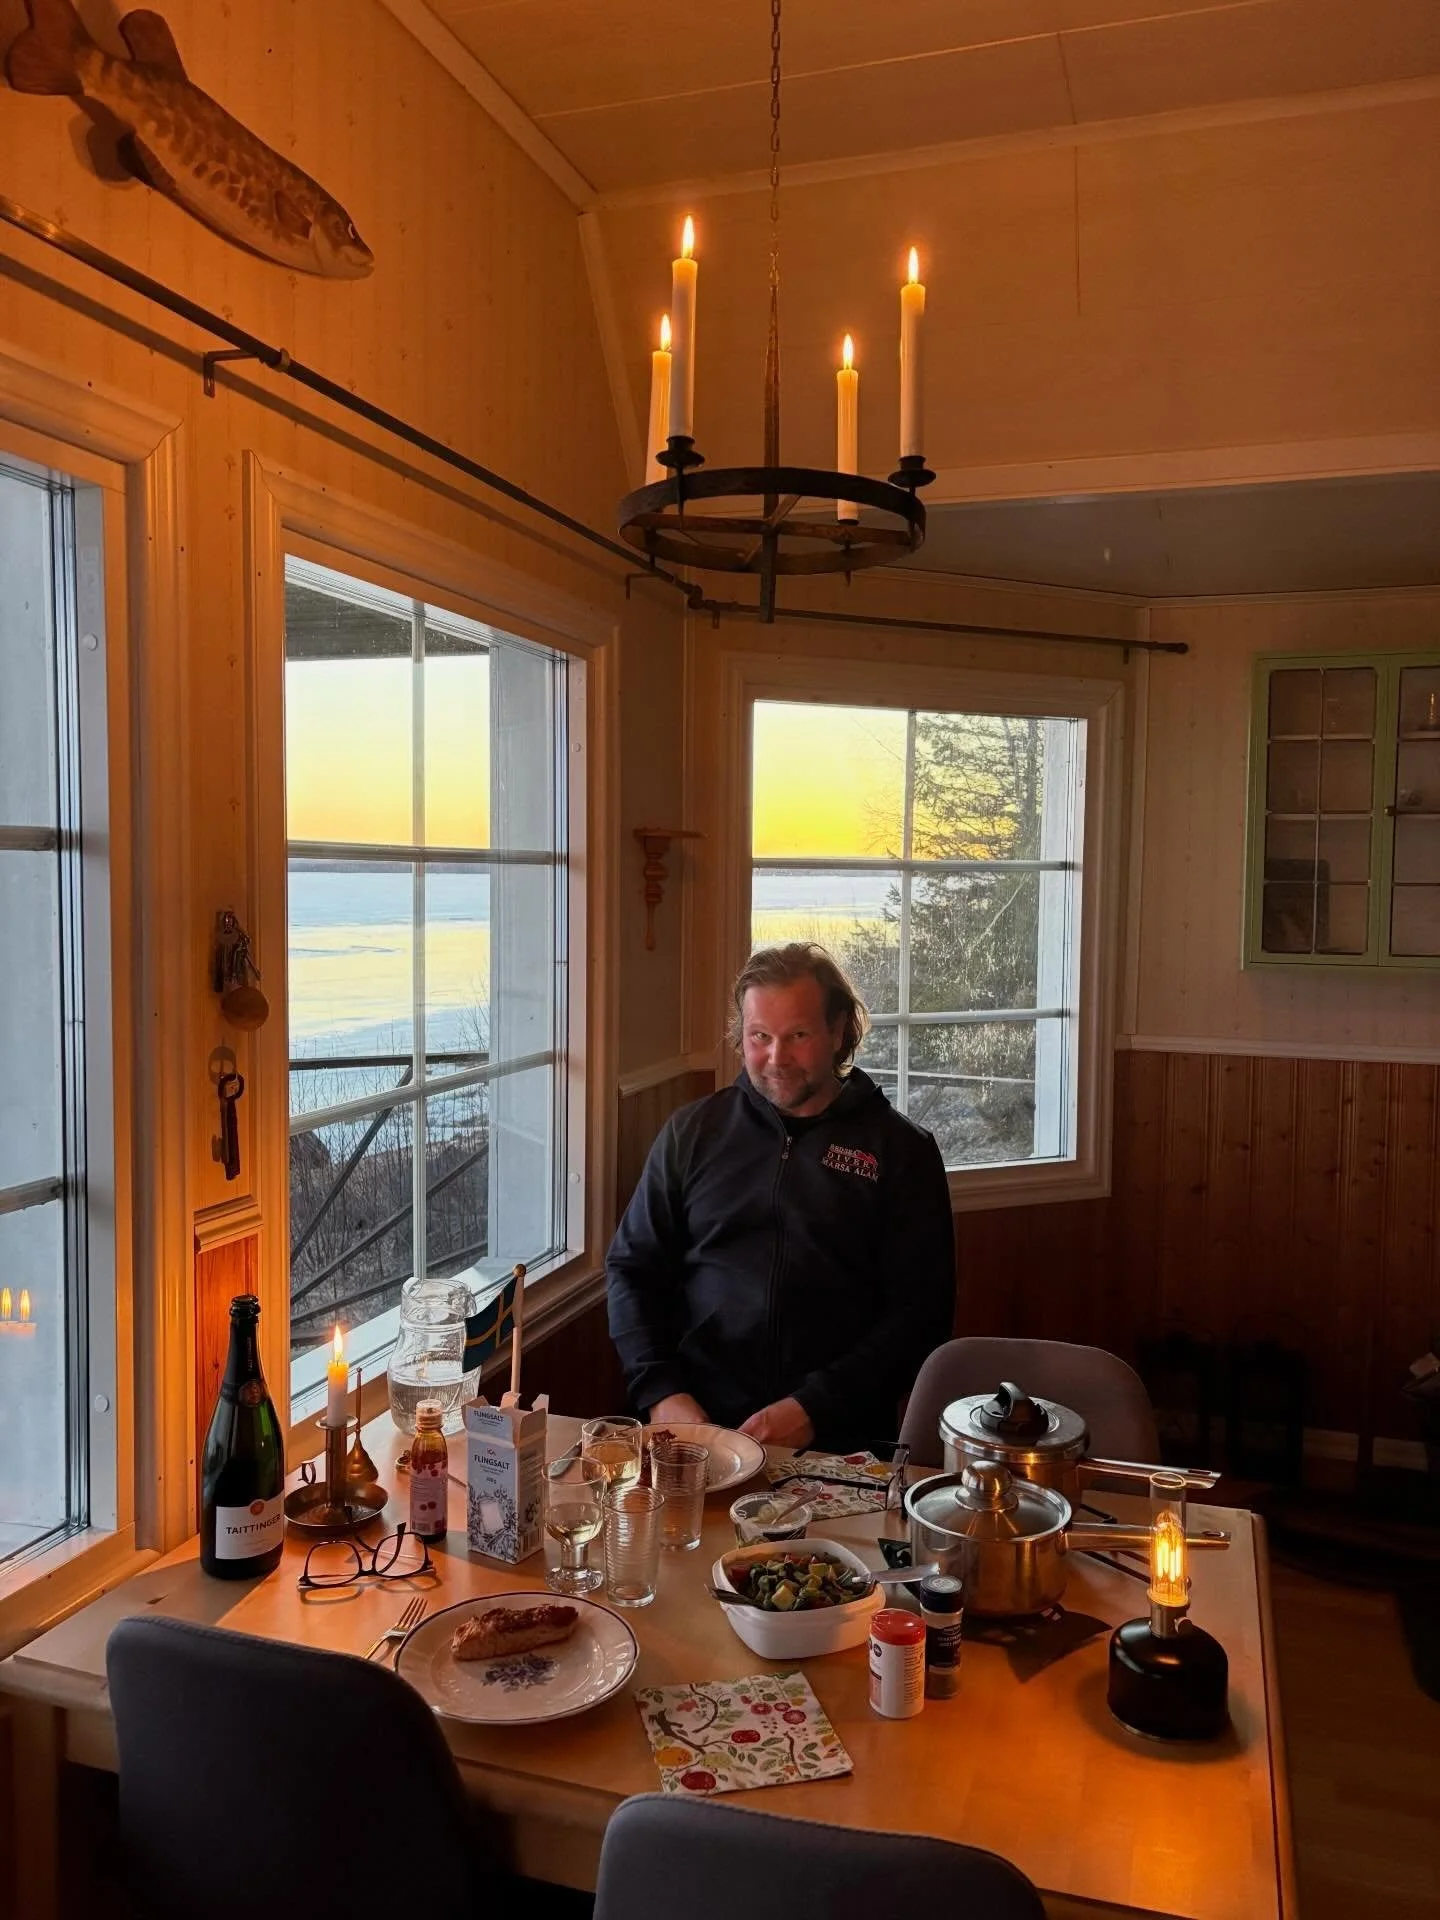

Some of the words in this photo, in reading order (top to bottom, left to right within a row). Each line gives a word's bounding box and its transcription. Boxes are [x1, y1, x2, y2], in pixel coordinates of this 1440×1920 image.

[473, 1410, 504, 1422] FLINGSALT
[474, 1454, 510, 1470] FLINGSALT
[225, 1513, 281, 1535] TAITTINGER
